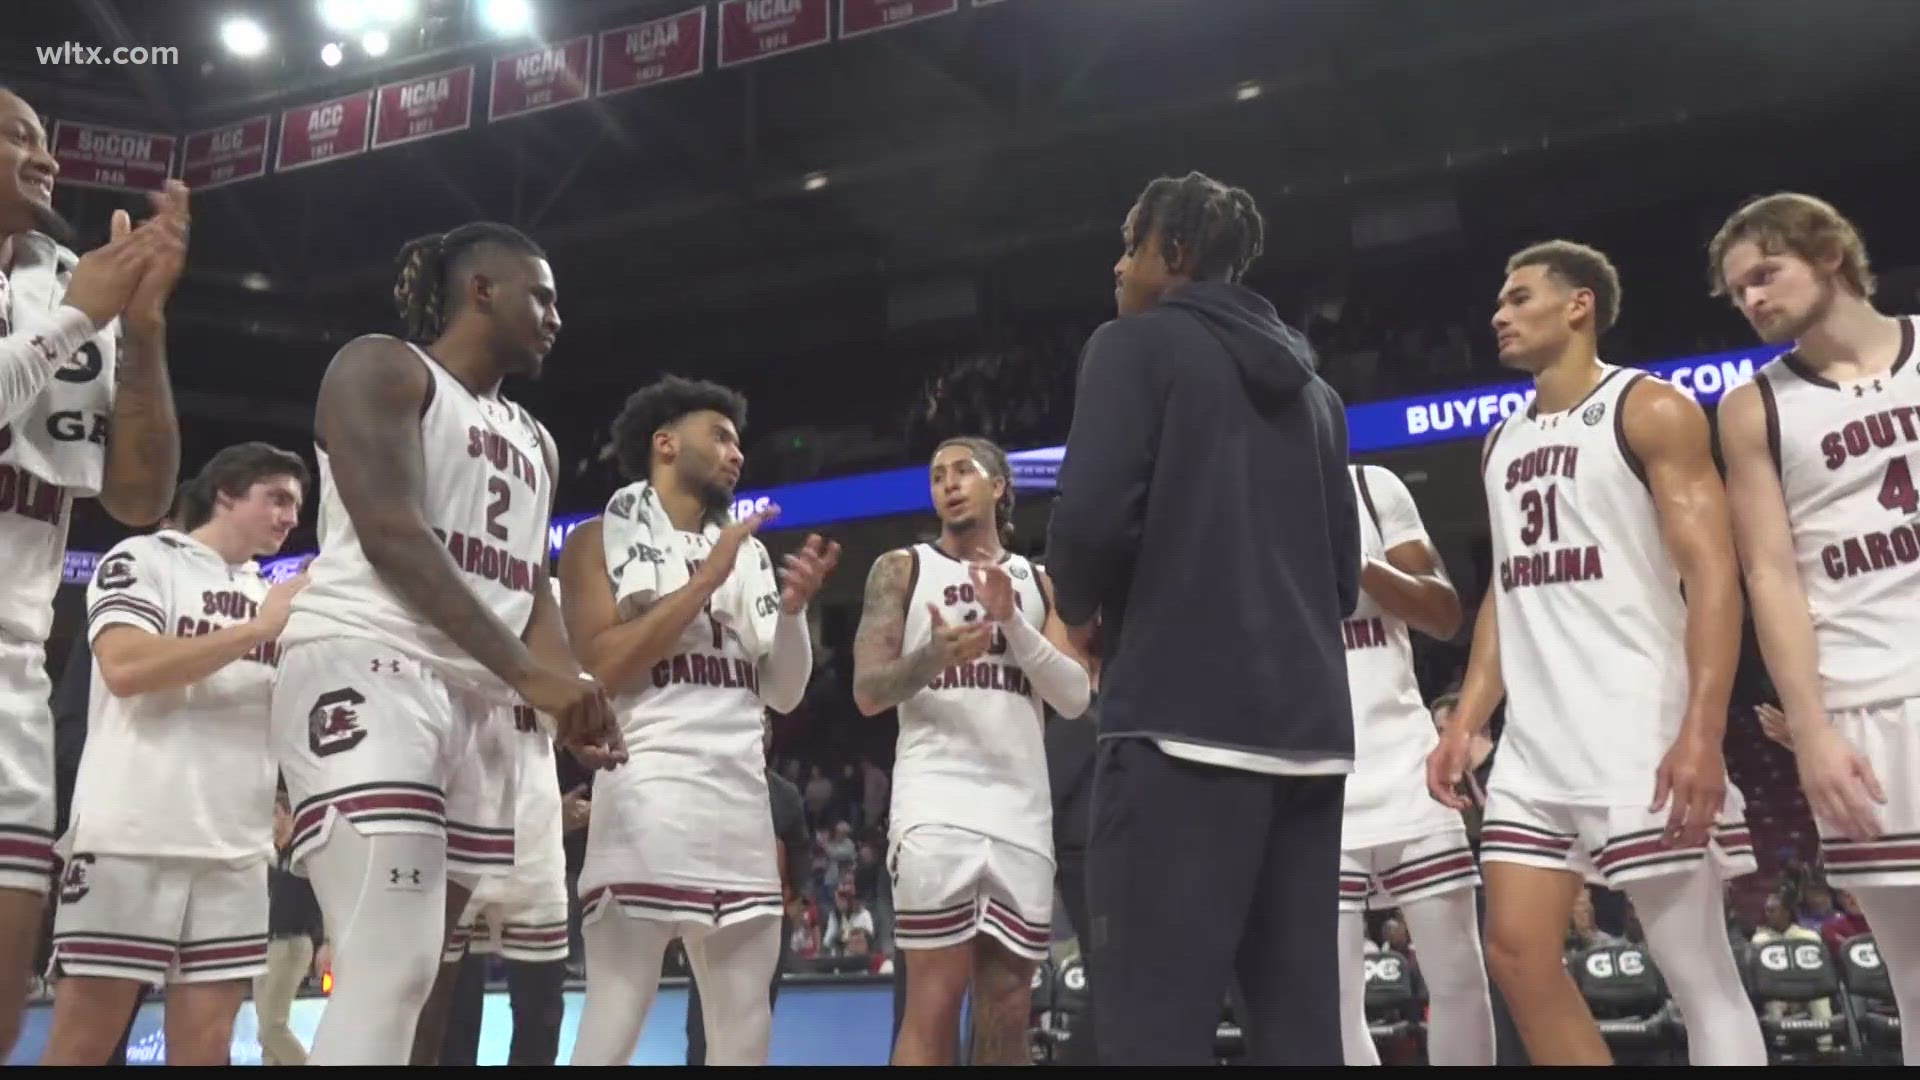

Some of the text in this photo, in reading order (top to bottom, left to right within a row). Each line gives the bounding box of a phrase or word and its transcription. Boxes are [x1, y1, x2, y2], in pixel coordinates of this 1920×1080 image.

[625, 20, 679, 54] NCAA
[516, 48, 565, 80] NCAA
[400, 77, 448, 109] NCAA
[307, 104, 343, 131] ACC
[79, 129, 151, 160] SoCON
[468, 425, 537, 494] SOUTH
[1505, 444, 1578, 491] SOUTH
[486, 475, 511, 541] 2
[1877, 455, 1920, 515] 4
[1520, 483, 1558, 546] 31
[1501, 545, 1603, 593] CAROLINA
[1821, 523, 1920, 580] CARO
[202, 590, 258, 618] SOUT
[651, 653, 760, 698] CAROLIN
